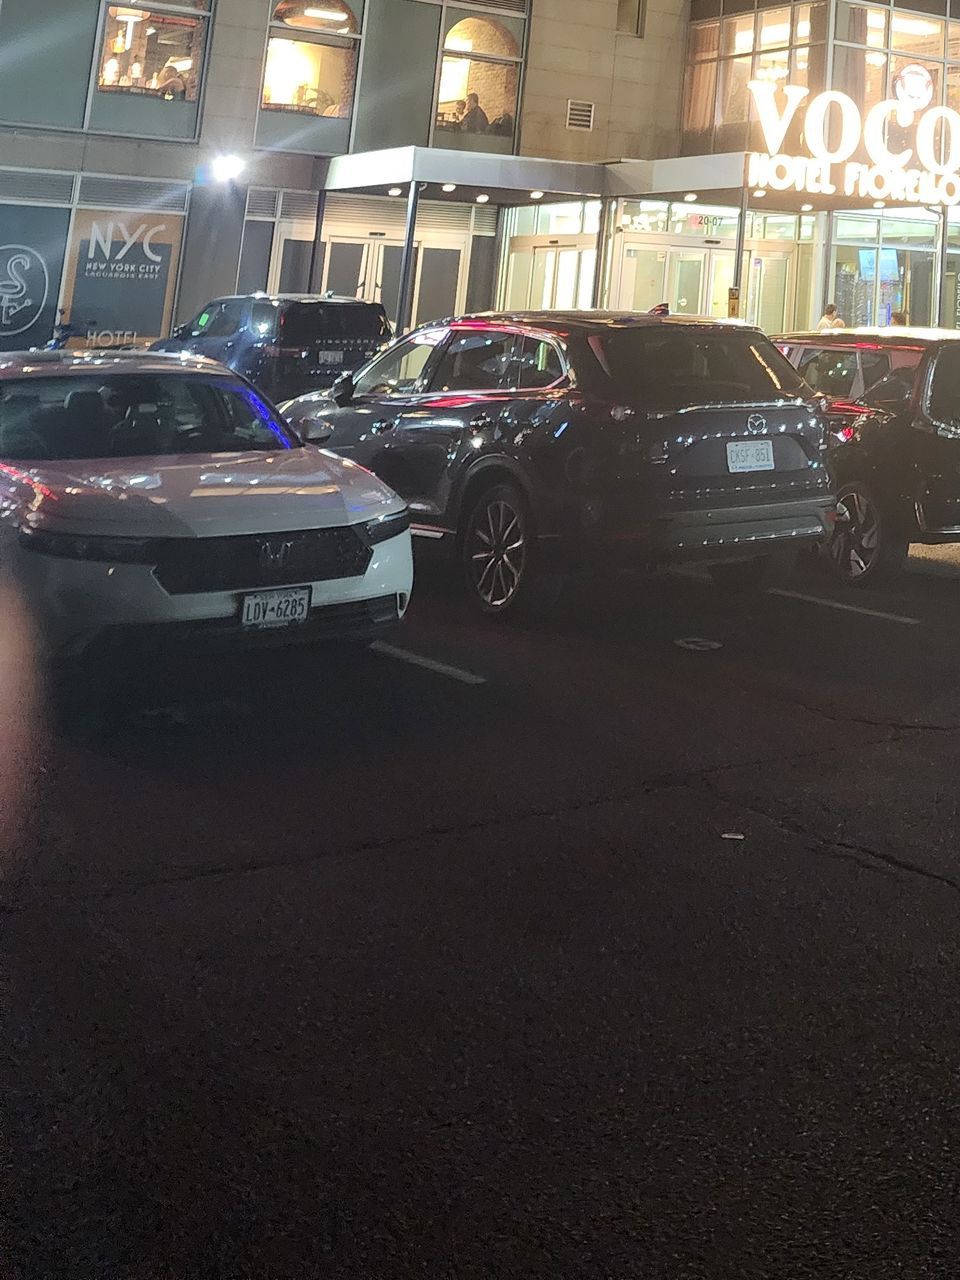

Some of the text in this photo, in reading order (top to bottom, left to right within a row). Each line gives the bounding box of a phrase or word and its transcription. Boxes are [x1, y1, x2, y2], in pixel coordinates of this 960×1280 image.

[748, 152, 837, 194] HOTEL
[697, 215, 724, 227] 20-07
[88, 220, 166, 263] NYC
[86, 261, 161, 274] NEW YORK CITY
